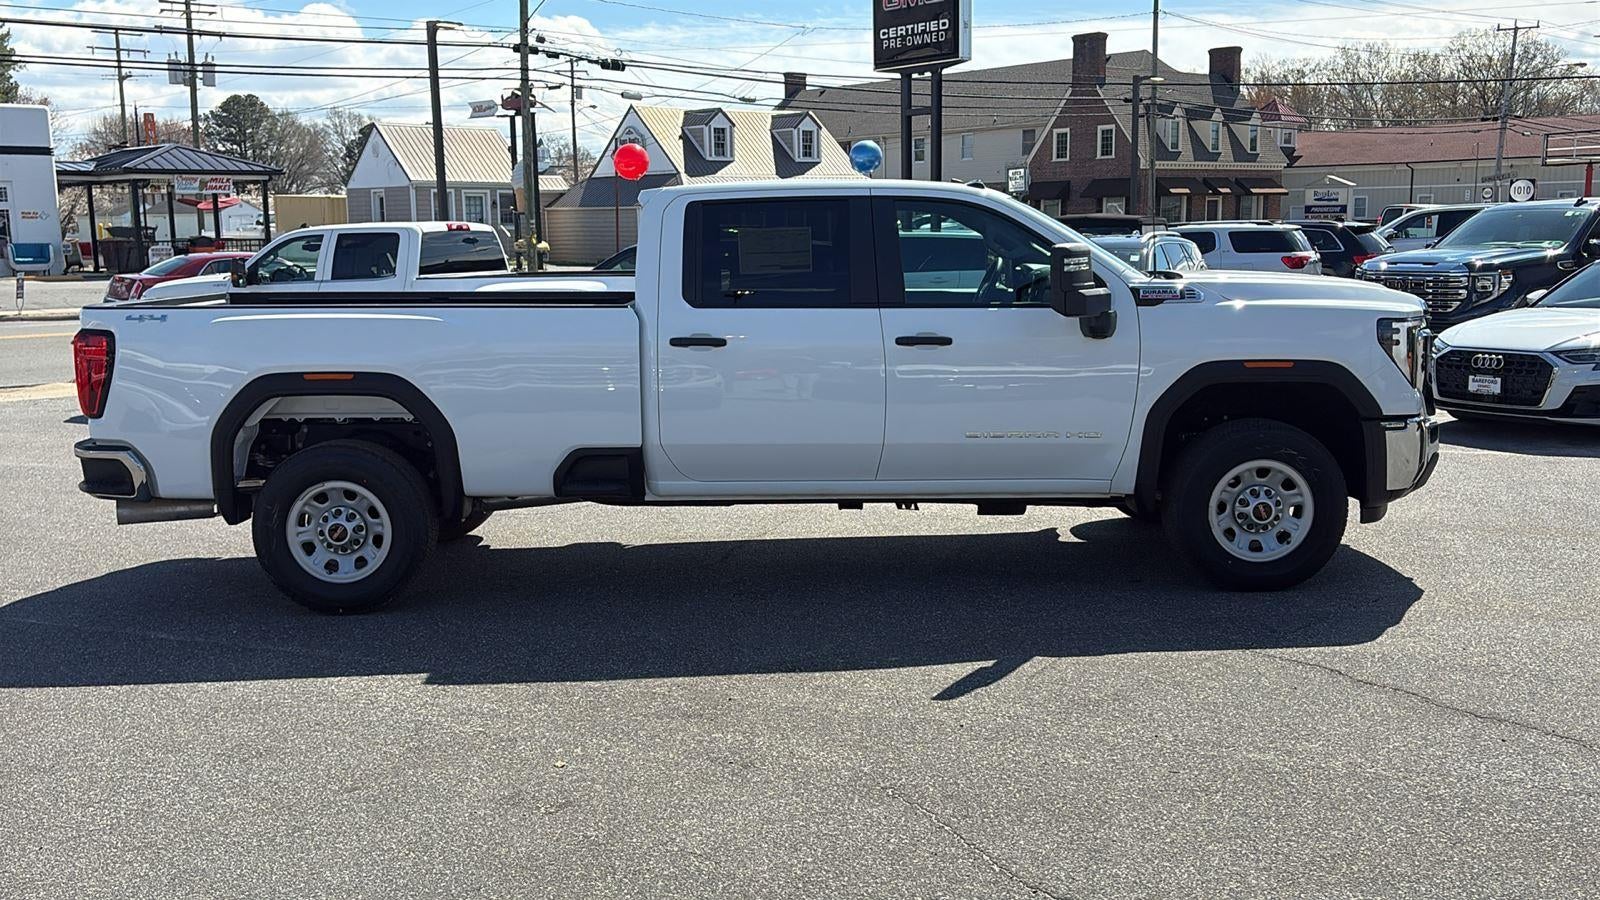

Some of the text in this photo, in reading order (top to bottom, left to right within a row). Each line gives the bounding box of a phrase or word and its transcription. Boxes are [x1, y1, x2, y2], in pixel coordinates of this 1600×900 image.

[880, 19, 949, 39] CERTIFIED
[883, 31, 945, 50] PRE-OWNED
[1513, 186, 1531, 195] 1010
[965, 431, 1103, 439] SIERRA HD
